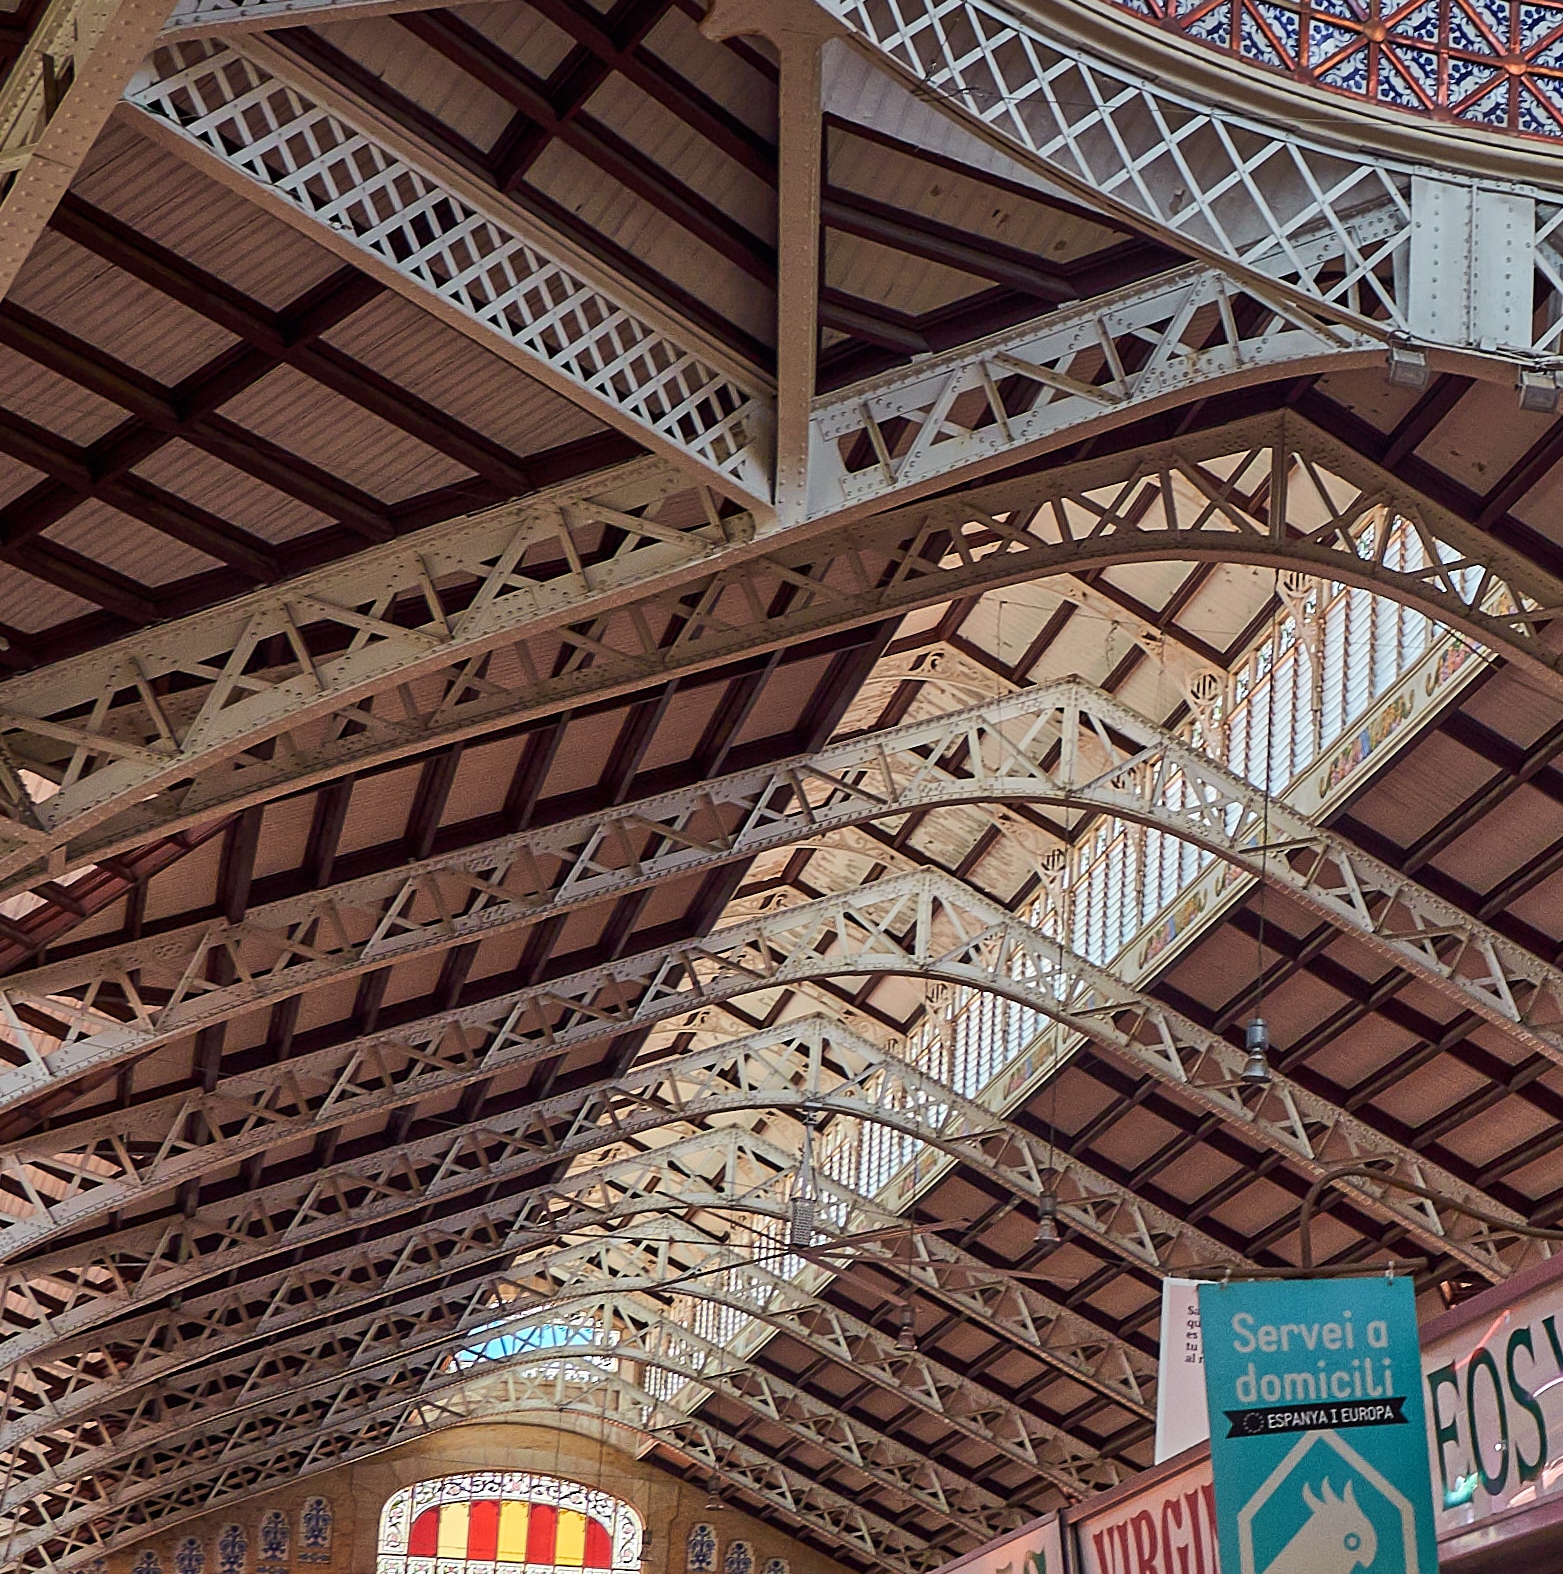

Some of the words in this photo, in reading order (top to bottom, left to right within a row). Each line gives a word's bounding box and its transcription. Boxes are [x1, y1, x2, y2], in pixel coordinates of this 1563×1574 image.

[1231, 1310, 1354, 1354] Servei
[1366, 1319, 1390, 1349] a
[1235, 1356, 1395, 1404] domicili
[1266, 1410, 1329, 1430] ESPANYA
[1341, 1404, 1395, 1423] EUROPA
